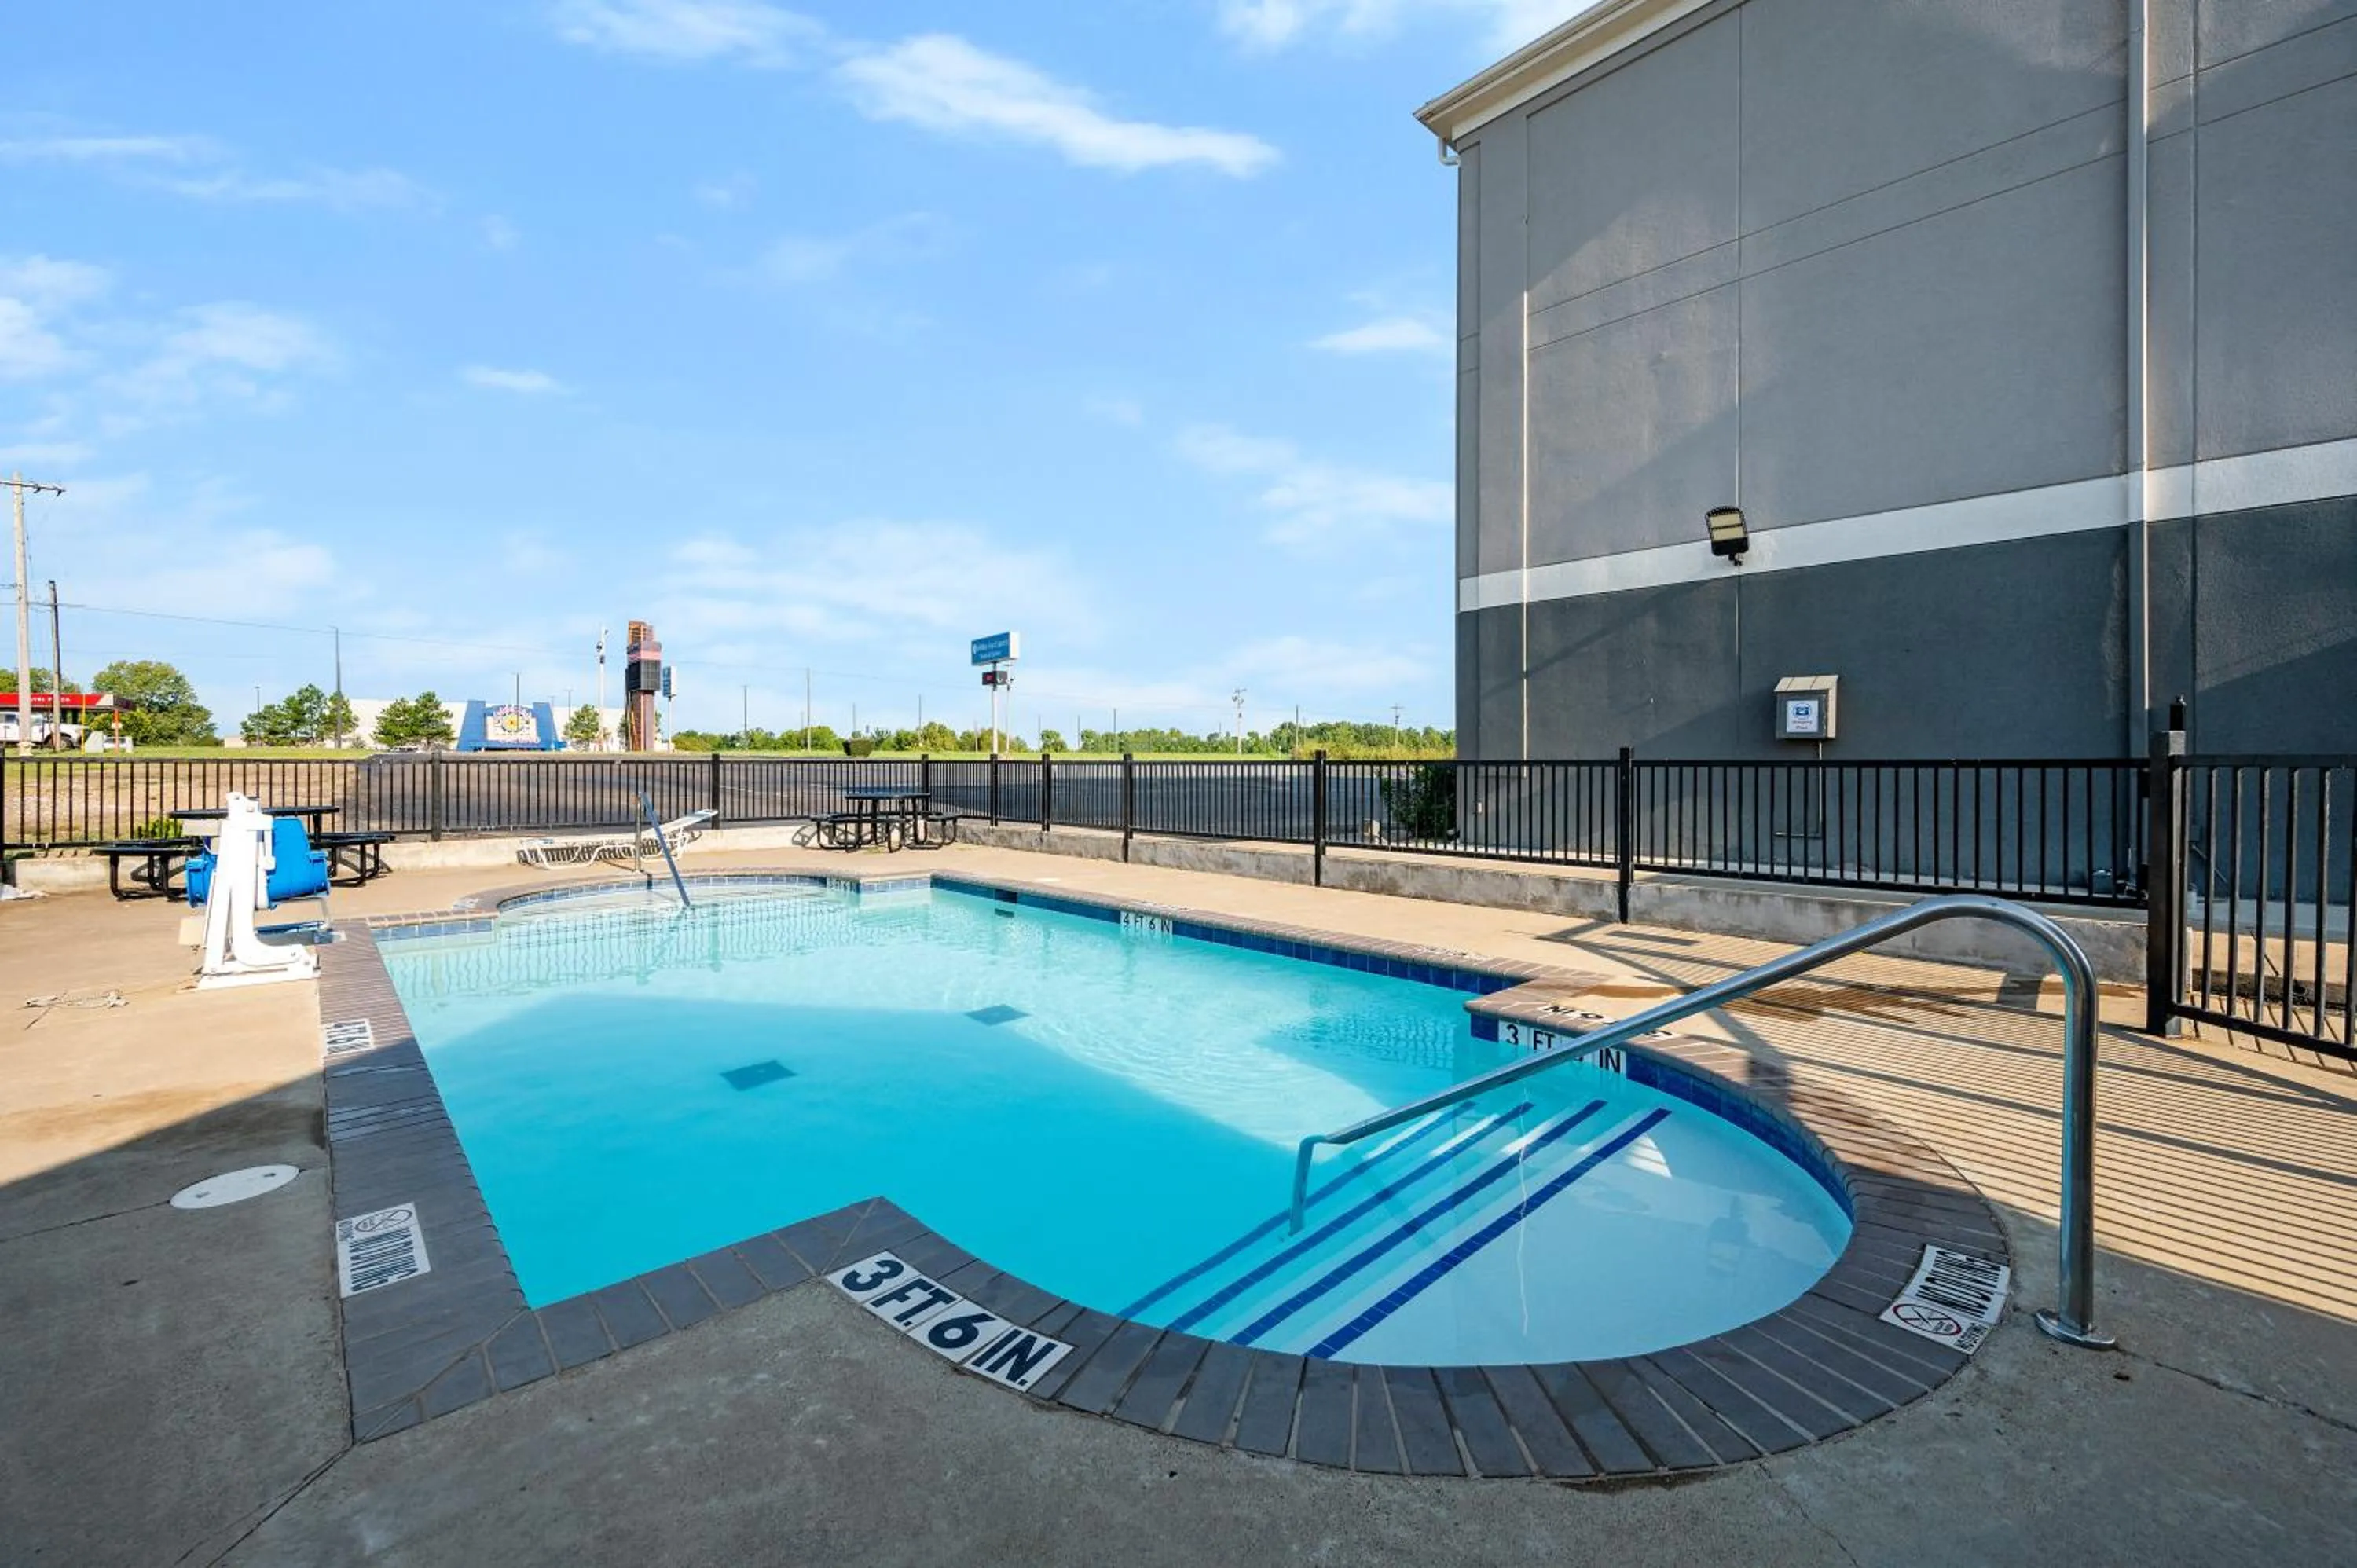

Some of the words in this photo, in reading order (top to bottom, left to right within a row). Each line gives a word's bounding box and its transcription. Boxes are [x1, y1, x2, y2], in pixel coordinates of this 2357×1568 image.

[1134, 914, 1144, 929] FT
[1149, 918, 1156, 931] 6
[1505, 1024, 1519, 1046] 3
[1533, 1030, 1556, 1050] FT
[1599, 1047, 1621, 1074] IN
[1925, 1250, 2001, 1302] DIVING
[841, 1259, 904, 1292] 3
[928, 1313, 996, 1349] 6
[1915, 1284, 1989, 1319] NO
